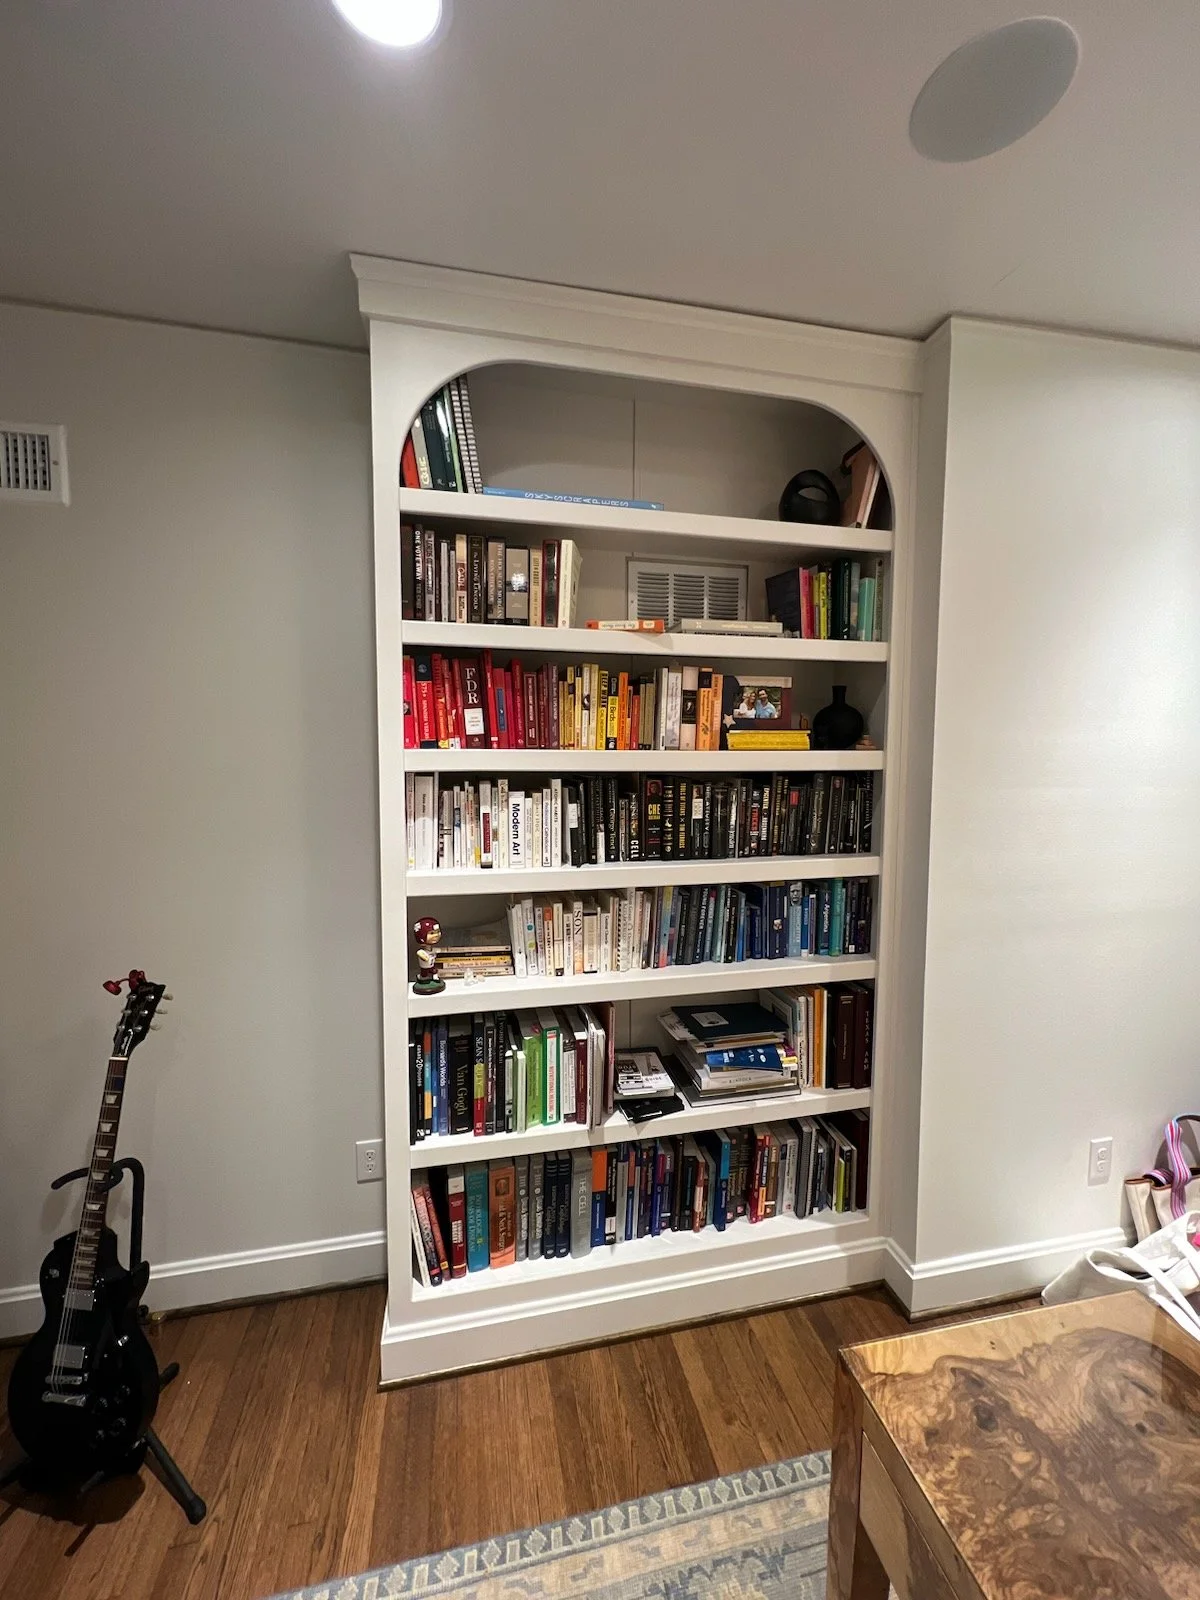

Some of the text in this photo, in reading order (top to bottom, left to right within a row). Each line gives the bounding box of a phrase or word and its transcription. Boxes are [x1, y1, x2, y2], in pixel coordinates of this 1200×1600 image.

[524, 492, 630, 507] SKYSCRAPERS
[465, 667, 480, 704] FDR
[648, 804, 661, 815] CHE
[512, 803, 520, 839] Modern
[631, 840, 639, 858] CELL
[475, 1037, 483, 1058] SEAN
[454, 1064, 468, 1116] Van Gogh
